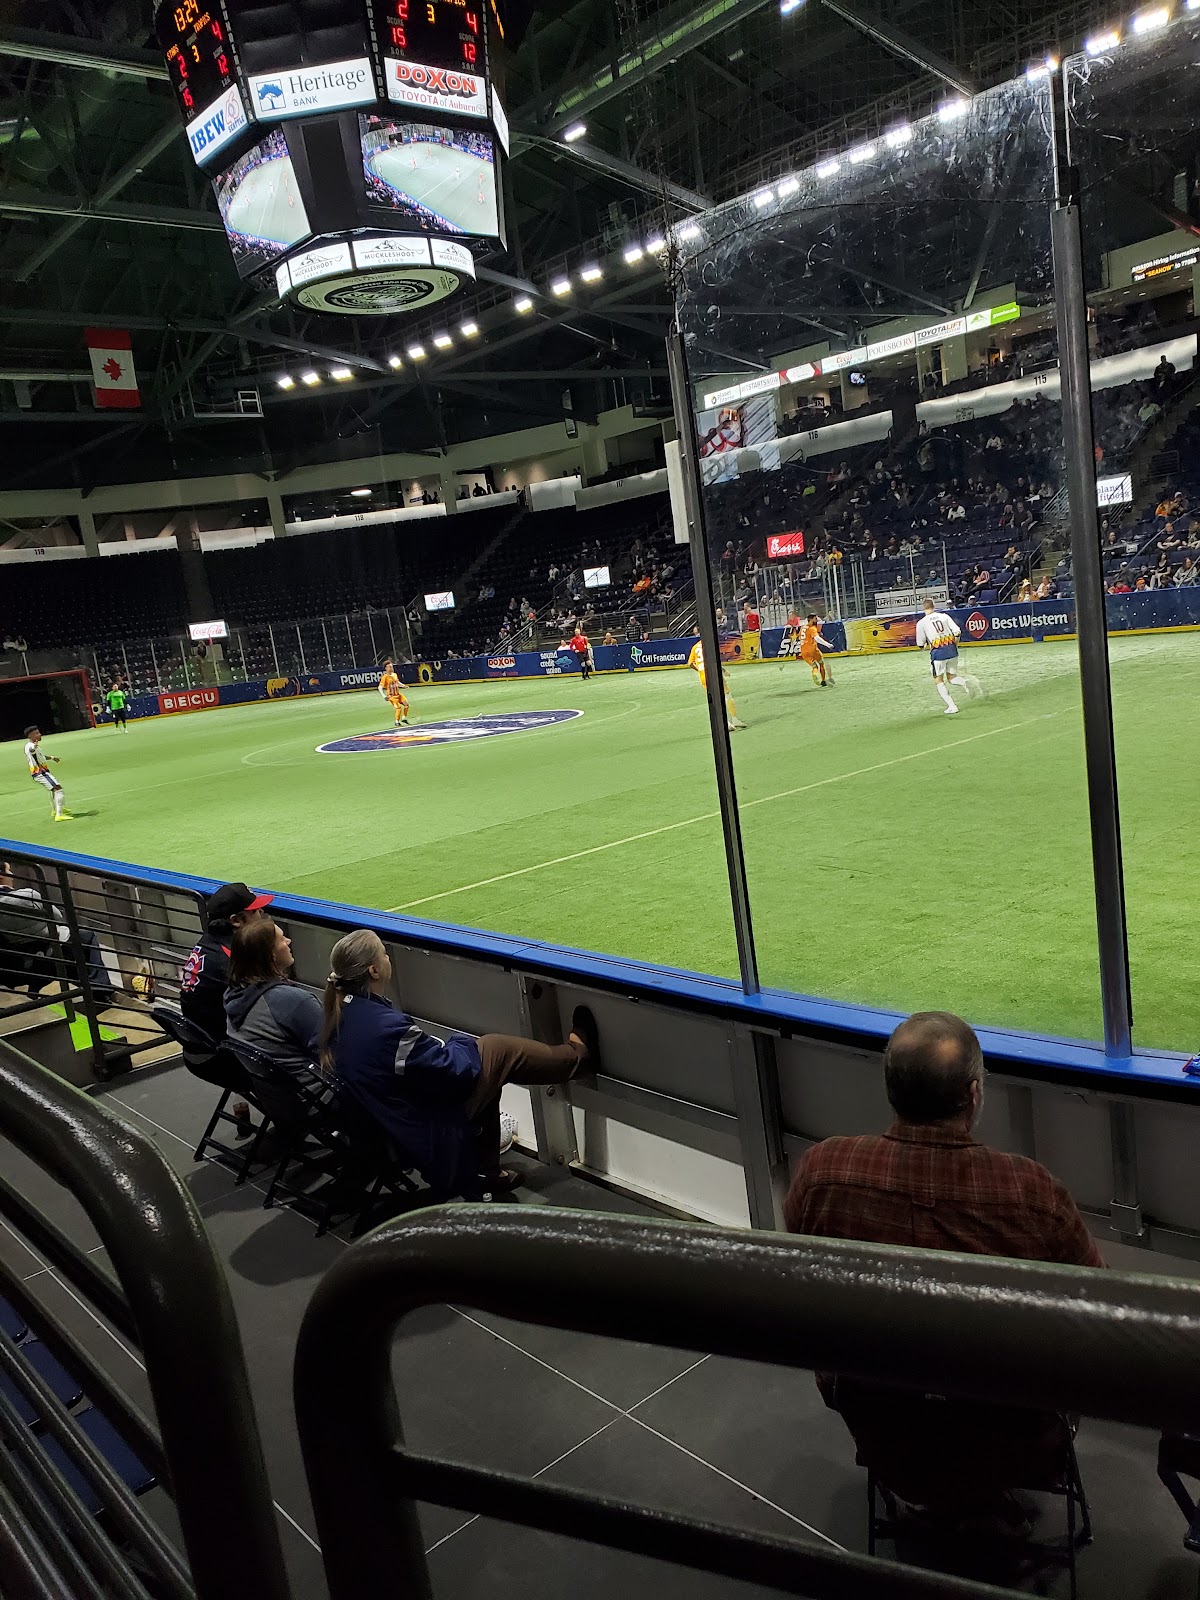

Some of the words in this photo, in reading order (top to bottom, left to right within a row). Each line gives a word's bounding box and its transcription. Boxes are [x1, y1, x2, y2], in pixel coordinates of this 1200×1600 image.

[426, 3, 436, 24] 3
[211, 20, 223, 41] 4
[466, 12, 478, 35] 4
[391, 27, 407, 48] 15
[191, 44, 200, 63] 3
[463, 43, 476, 63] 12
[288, 68, 367, 95] Heritage
[396, 62, 478, 99] DOXON
[293, 95, 319, 107] BANK
[400, 89, 439, 107] TOYOTA
[439, 98, 448, 107] of
[448, 100, 477, 113] Auburn
[190, 109, 226, 155] IBEW
[363, 251, 415, 260] MUCKLESHOOT
[294, 261, 334, 278] MUCKLESHOOT
[868, 341, 902, 358] POULSBO
[903, 335, 914, 348] RV
[1033, 374, 1047, 386] 115
[808, 430, 819, 441] 116
[931, 620, 945, 633] 10
[968, 620, 986, 632] BW
[992, 617, 1018, 630] Best
[1019, 613, 1069, 627] Western
[488, 657, 516, 669] DOXON
[642, 654, 653, 663] CHI
[653, 652, 686, 662] Franciscan
